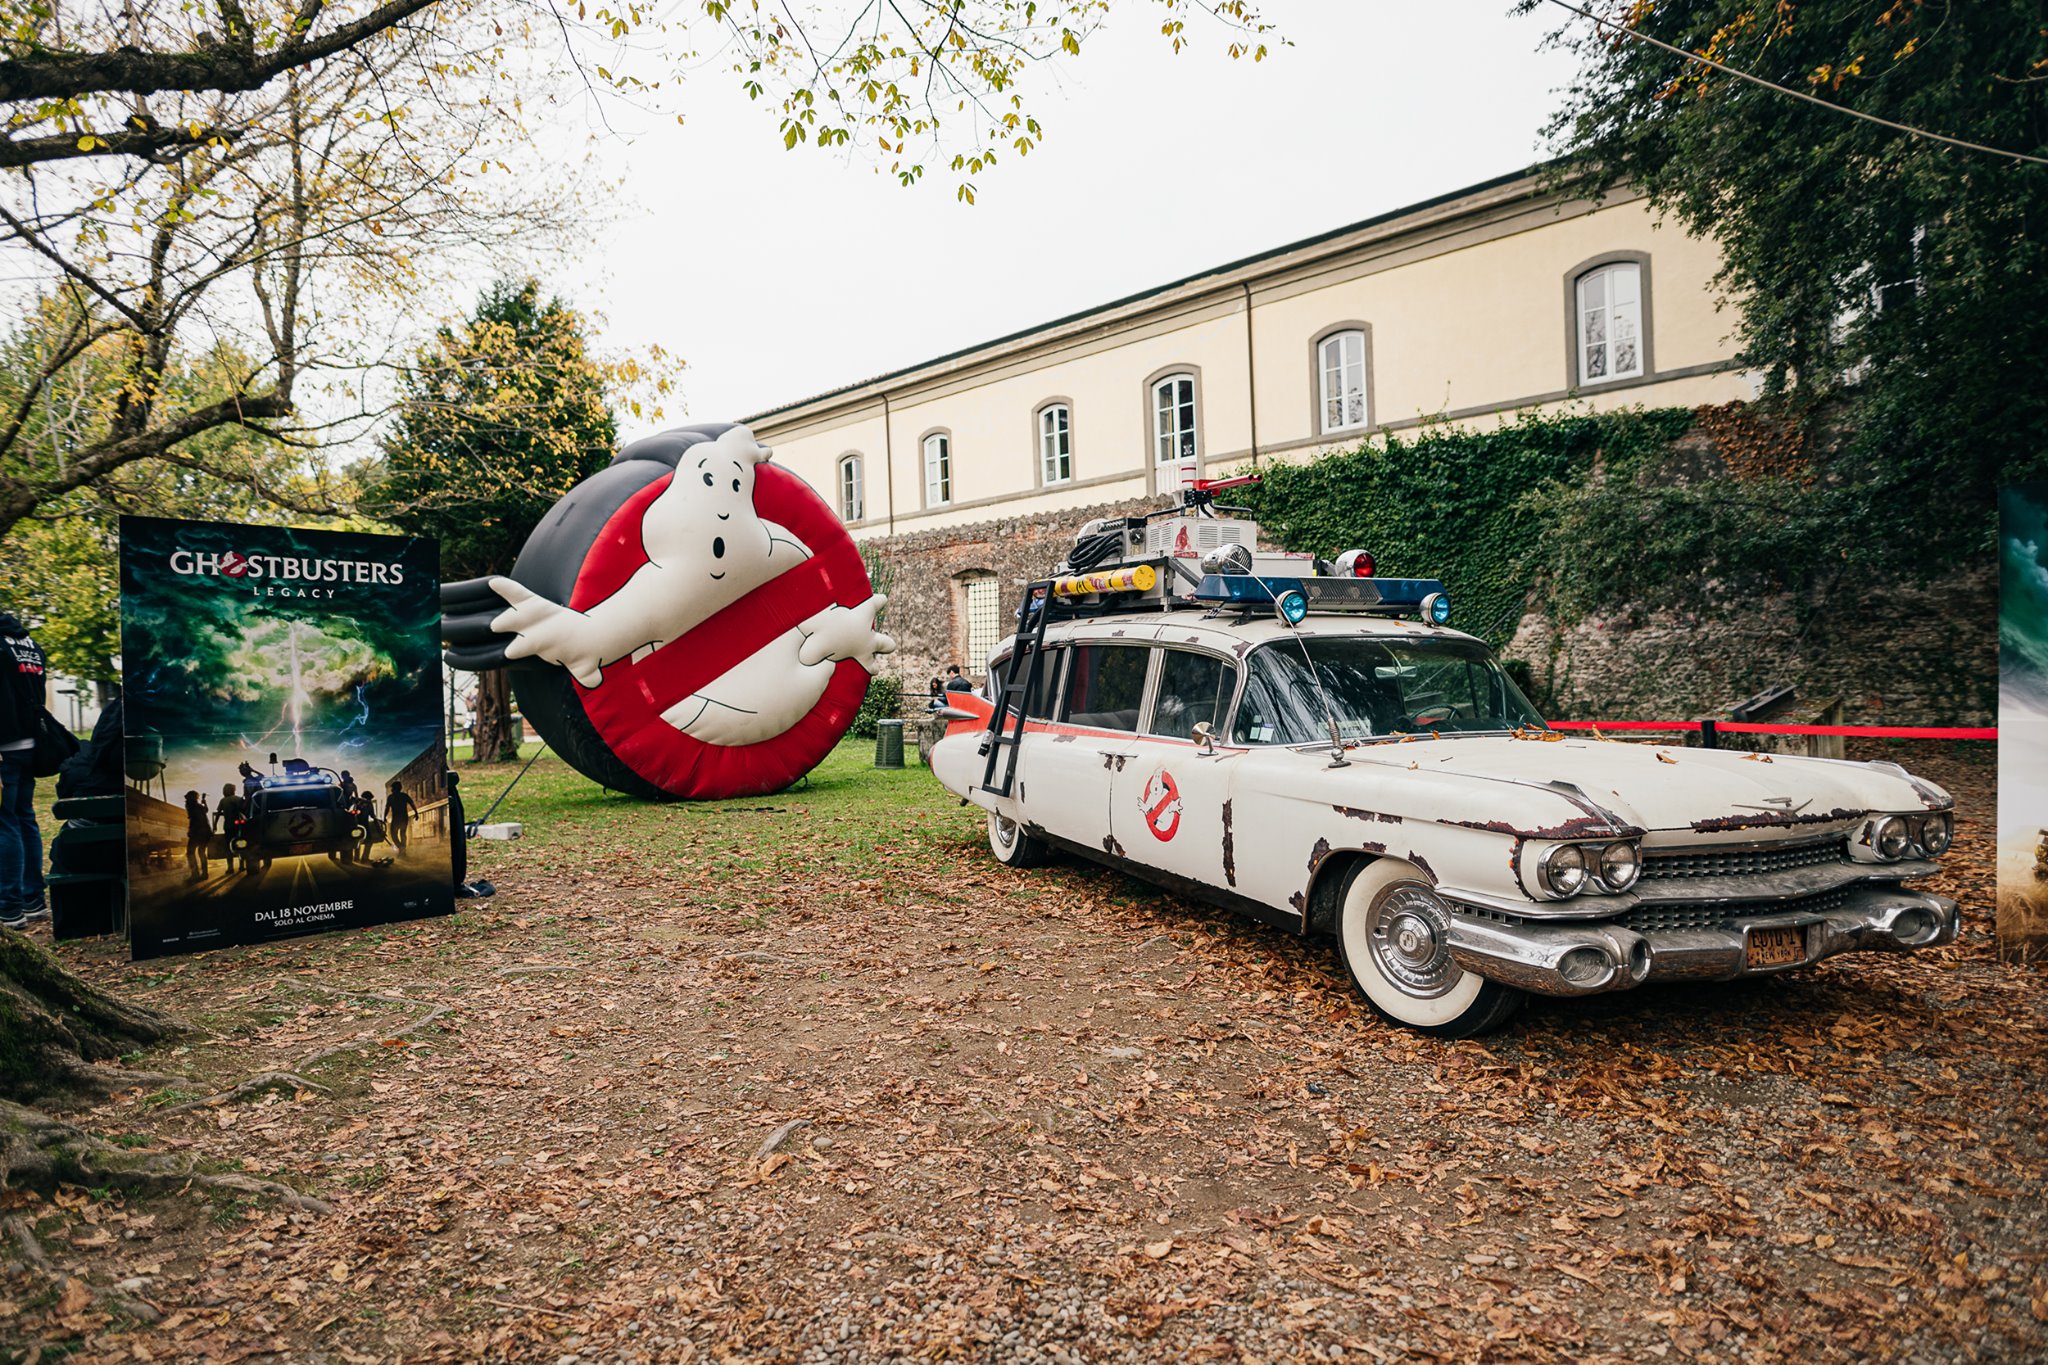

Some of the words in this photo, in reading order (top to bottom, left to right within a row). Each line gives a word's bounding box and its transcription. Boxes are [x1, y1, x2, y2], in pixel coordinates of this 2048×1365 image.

[169, 551, 404, 585] GHOSTBUSTERS
[253, 586, 335, 599] LEGACY
[255, 911, 278, 922] DAL
[280, 908, 291, 918] 18
[293, 900, 354, 916] NOVEMBRE
[274, 918, 294, 927] SOLO
[306, 913, 335, 922] CINEMA
